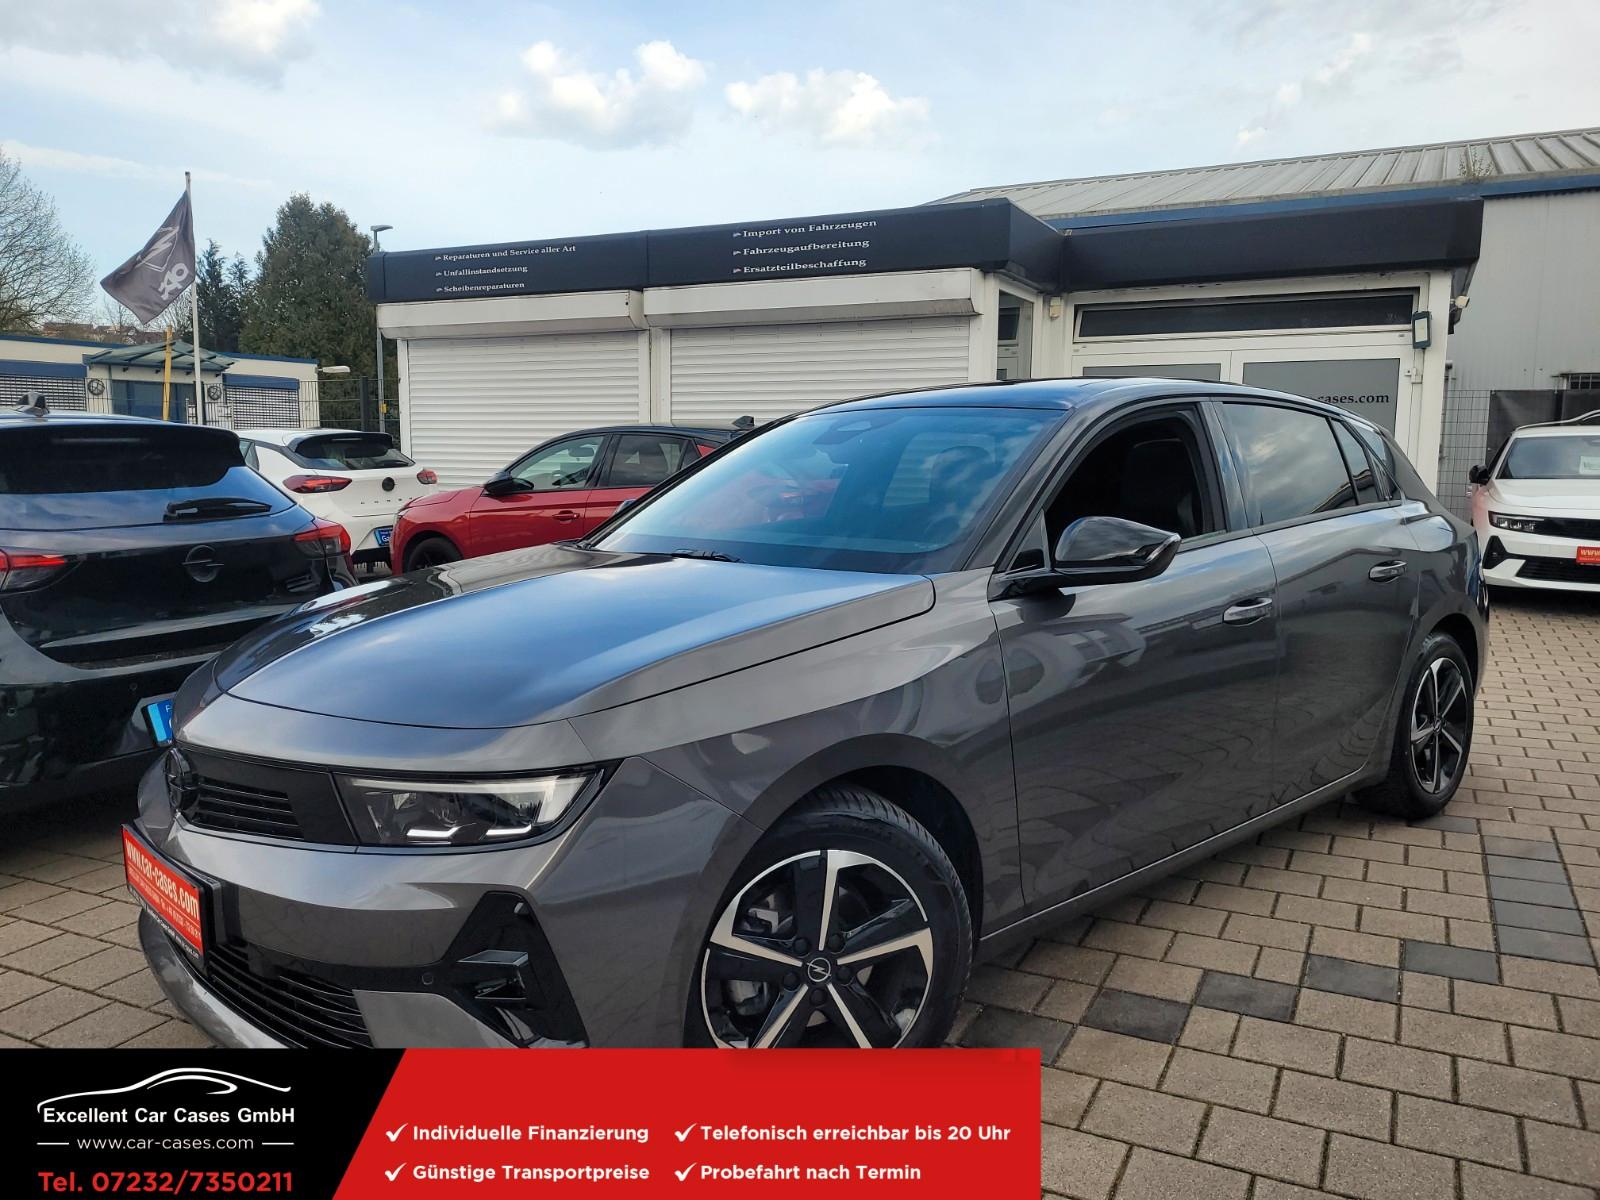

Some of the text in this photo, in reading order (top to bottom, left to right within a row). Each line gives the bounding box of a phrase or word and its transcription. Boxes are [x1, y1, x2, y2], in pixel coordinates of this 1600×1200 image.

[743, 219, 878, 239] Import von Fahrzeugen
[442, 251, 490, 262] Reparaturen
[492, 250, 508, 258] und
[509, 247, 540, 256] Service
[541, 246, 560, 254] aller
[743, 239, 870, 256] Fahrzeugaufbereitung
[443, 265, 528, 277] Unfallinstandsetzung
[743, 258, 867, 273] Ersatzteilbeschaffung
[443, 282, 525, 293] Scheibenreparaturen
[125, 838, 201, 921] www.car-cases.com
